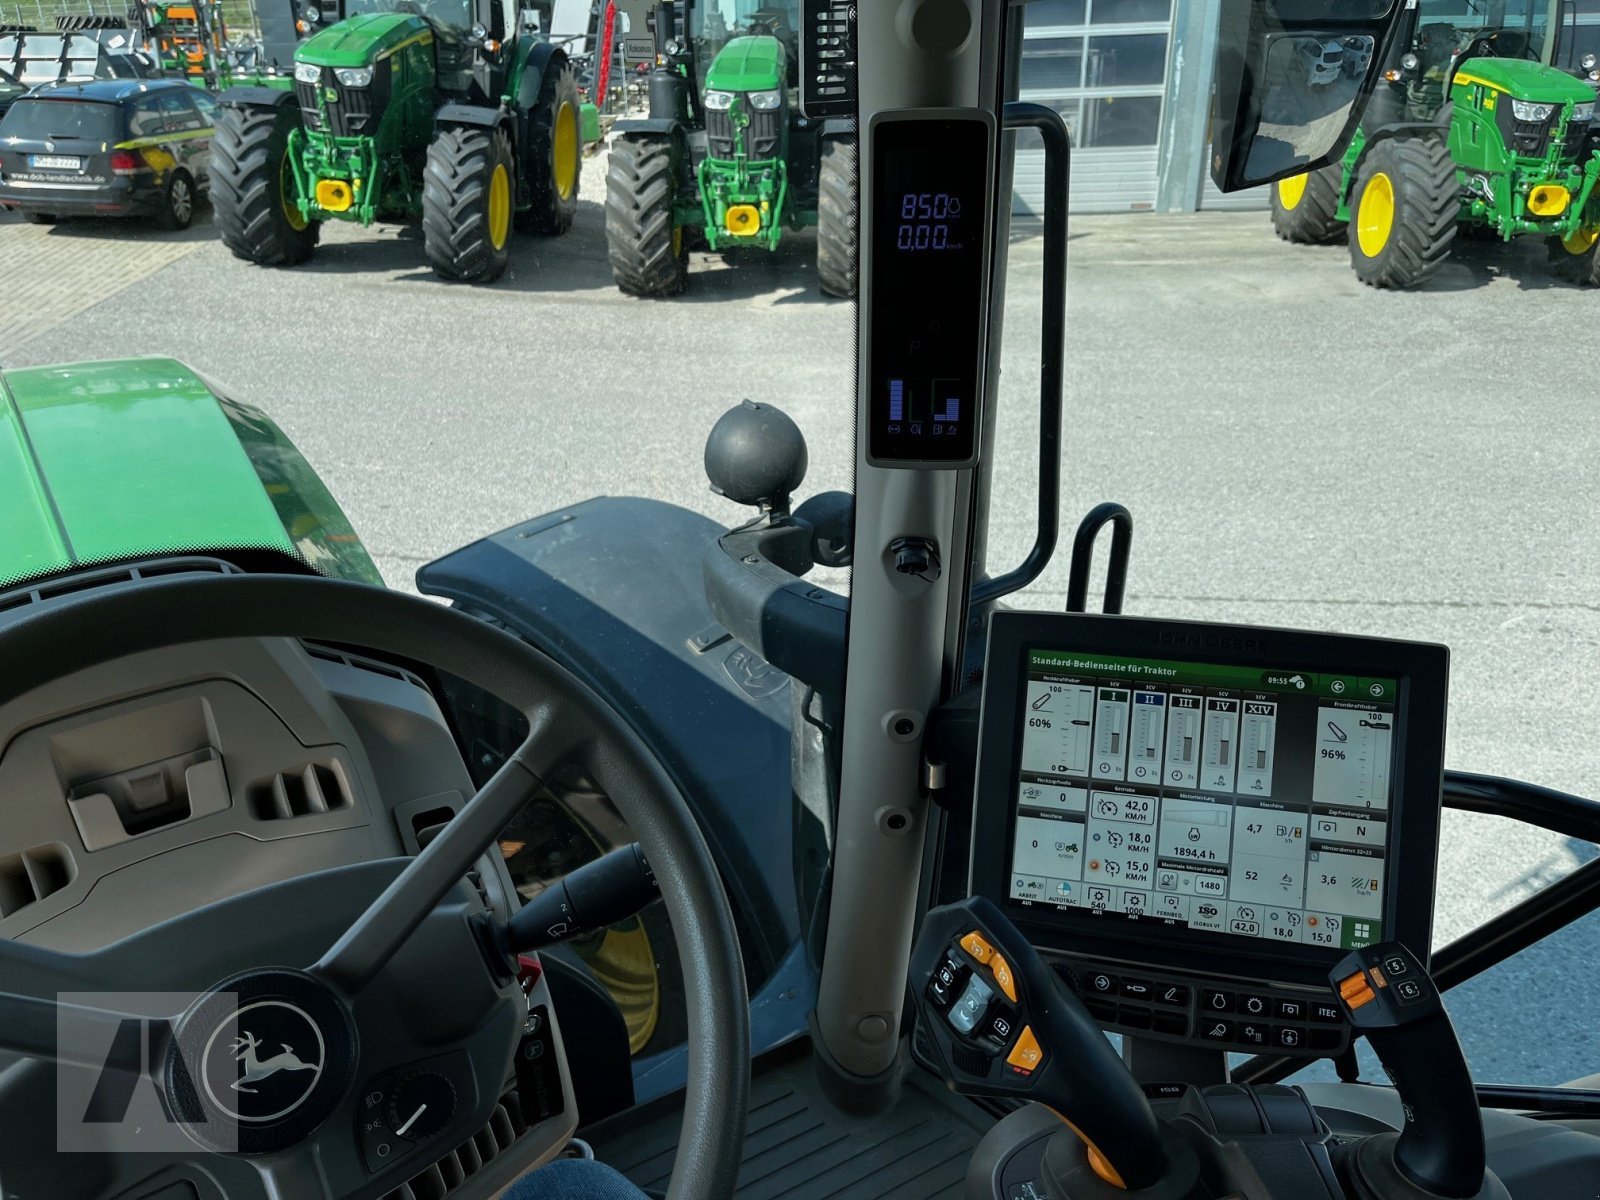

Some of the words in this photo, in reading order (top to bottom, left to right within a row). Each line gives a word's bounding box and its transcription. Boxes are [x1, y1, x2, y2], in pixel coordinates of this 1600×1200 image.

[902, 194, 948, 219] 850
[1032, 656, 1126, 672] Standard-Bedienseite
[1128, 664, 1142, 673] für
[1144, 666, 1177, 676] Traktor
[1268, 676, 1288, 685] 09:55
[1144, 695, 1155, 704] II
[1179, 698, 1193, 708] III
[1216, 701, 1230, 711] IV
[1248, 705, 1271, 715] XIV
[1368, 713, 1383, 721] 100
[1029, 717, 1051, 729] 60%
[1321, 749, 1346, 760] 96%
[1060, 793, 1066, 801] 0
[1125, 800, 1148, 811] 42,0
[1125, 812, 1146, 821] KM/H
[1247, 824, 1263, 834] 4,7
[1356, 826, 1366, 836] N
[1128, 832, 1151, 843] 18,0
[1032, 840, 1038, 848] 0
[1127, 844, 1149, 853] KM/H
[1174, 846, 1206, 859] 1894,4
[1209, 850, 1215, 859] h
[1127, 861, 1149, 872] 15,0
[1125, 872, 1147, 882] KM/H
[1245, 871, 1258, 881] 52
[1321, 875, 1337, 885] 3,6
[1200, 881, 1220, 890] 1480
[1048, 896, 1077, 904] AUTOTRAC
[560, 903, 568, 912] 2
[1091, 902, 1106, 910] 540
[1198, 906, 1218, 916] ISO
[1234, 922, 1255, 932] 42,0
[1273, 927, 1293, 938] 18,0
[1311, 932, 1332, 943] 15,0
[1392, 961, 1400, 970] 5
[1318, 1008, 1337, 1017] iTEC
[998, 1022, 1007, 1032] 12
